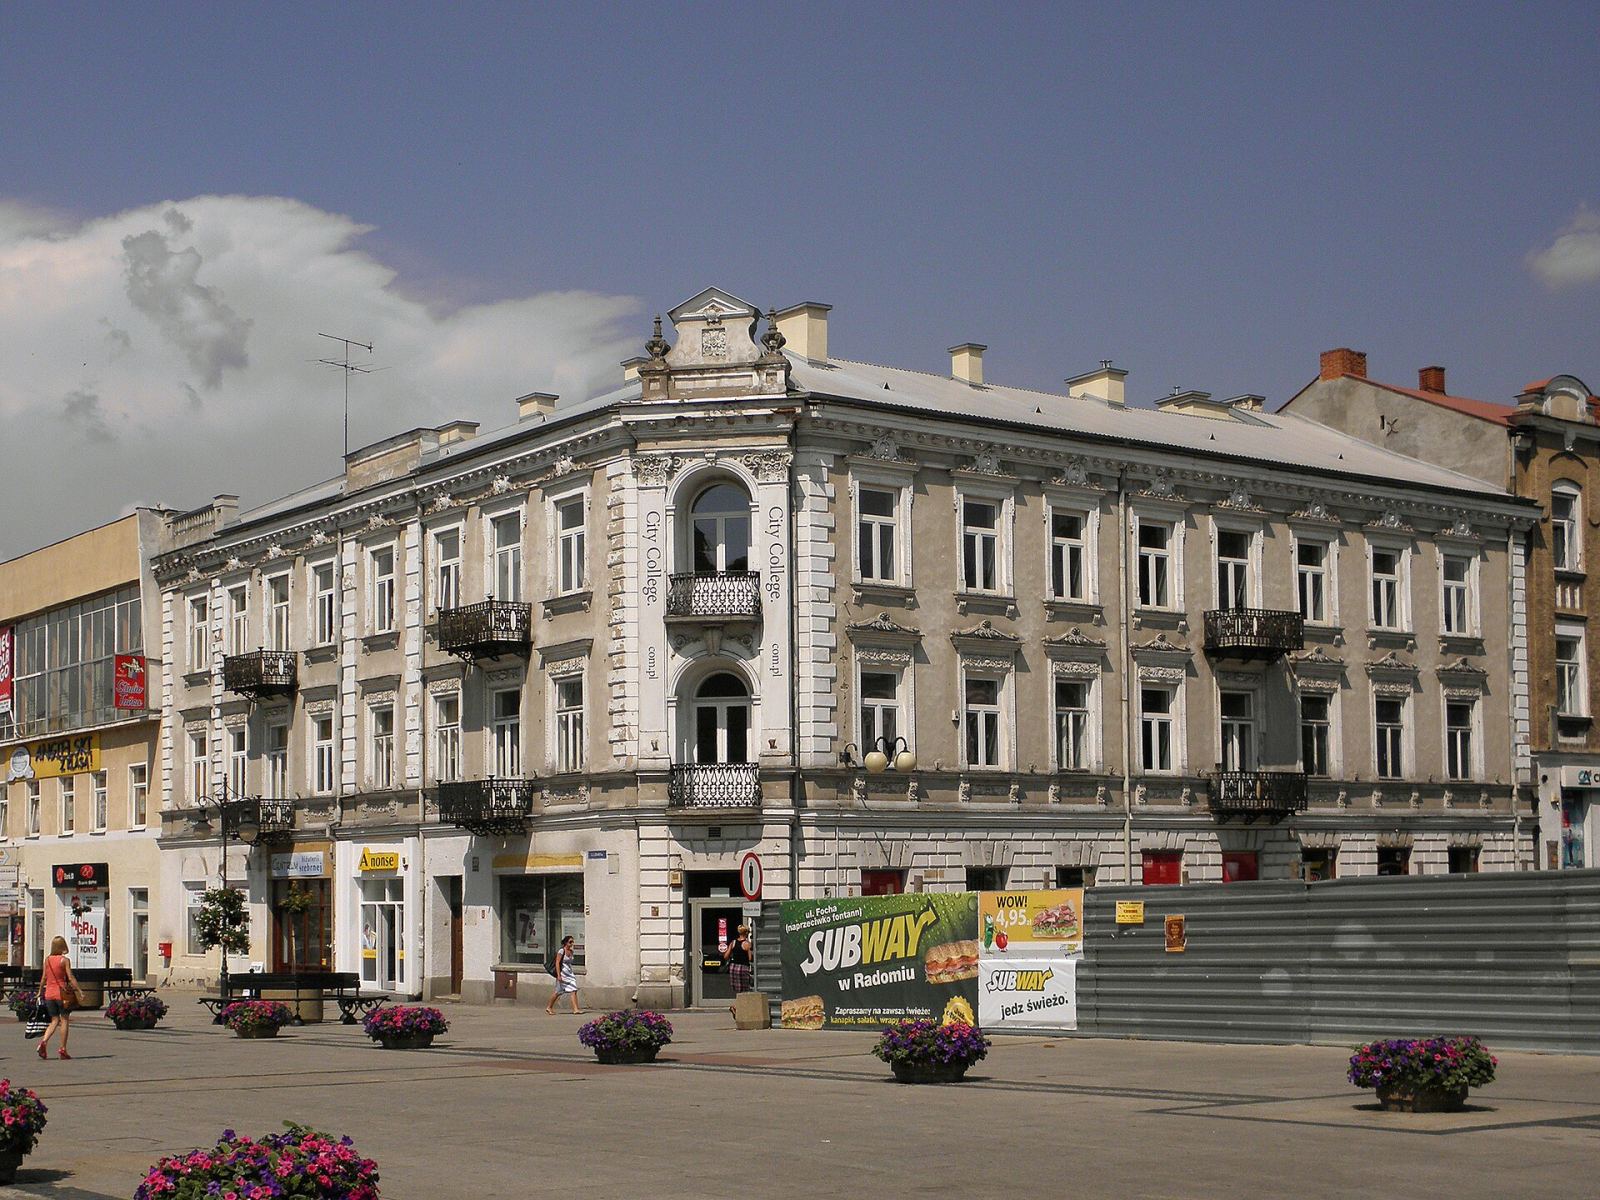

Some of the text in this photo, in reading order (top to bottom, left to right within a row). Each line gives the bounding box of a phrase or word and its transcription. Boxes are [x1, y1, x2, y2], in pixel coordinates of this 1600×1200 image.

[642, 510, 662, 606] City College.
[765, 506, 785, 603] City College.
[646, 646, 659, 680] com.pl
[768, 643, 782, 677] com.pl
[805, 905, 838, 919] ul. Focha
[996, 895, 1028, 908] WOW!
[785, 907, 863, 934] (naprzeciwko fontann)
[800, 905, 937, 977] SUBWAY
[838, 965, 916, 991] w Radomiu
[985, 967, 1054, 993] SUBWAY
[835, 1006, 872, 1016] Zapraszamy
[1001, 993, 1069, 1020] jedz świeżo.
